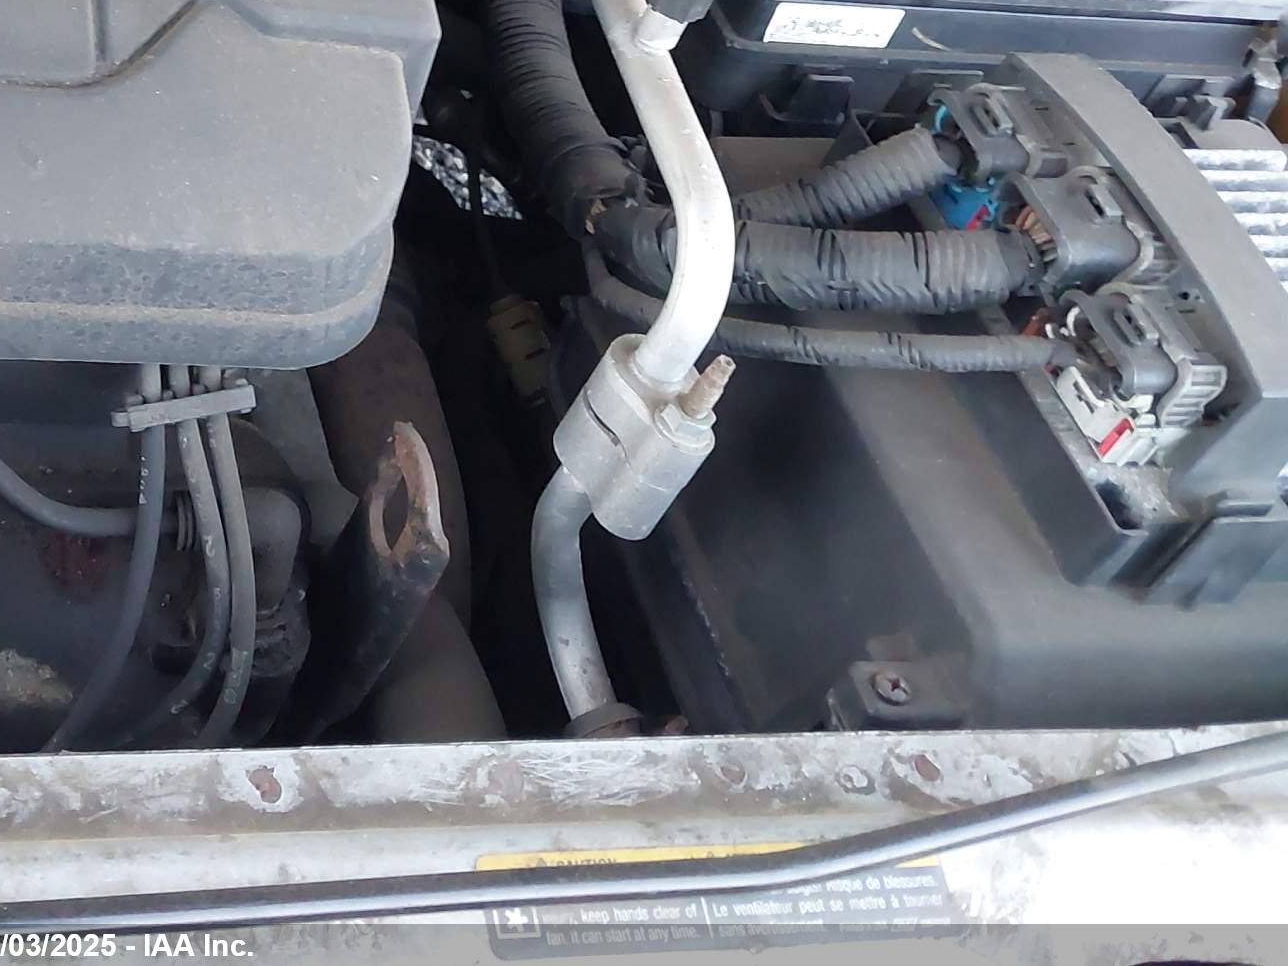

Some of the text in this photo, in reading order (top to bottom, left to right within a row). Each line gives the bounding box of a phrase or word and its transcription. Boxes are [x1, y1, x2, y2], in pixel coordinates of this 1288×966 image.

[865, 876, 881, 889] de
[580, 907, 610, 924] keep
[613, 905, 649, 922] hands
[652, 904, 681, 920] clear
[685, 903, 697, 918] of
[713, 900, 728, 917] Le
[799, 898, 825, 915] peut
[831, 898, 844, 912] se
[849, 895, 887, 911] mettre
[582, 930, 606, 945] can
[606, 927, 632, 943] start
[632, 927, 647, 942] at
[647, 927, 670, 943] any
